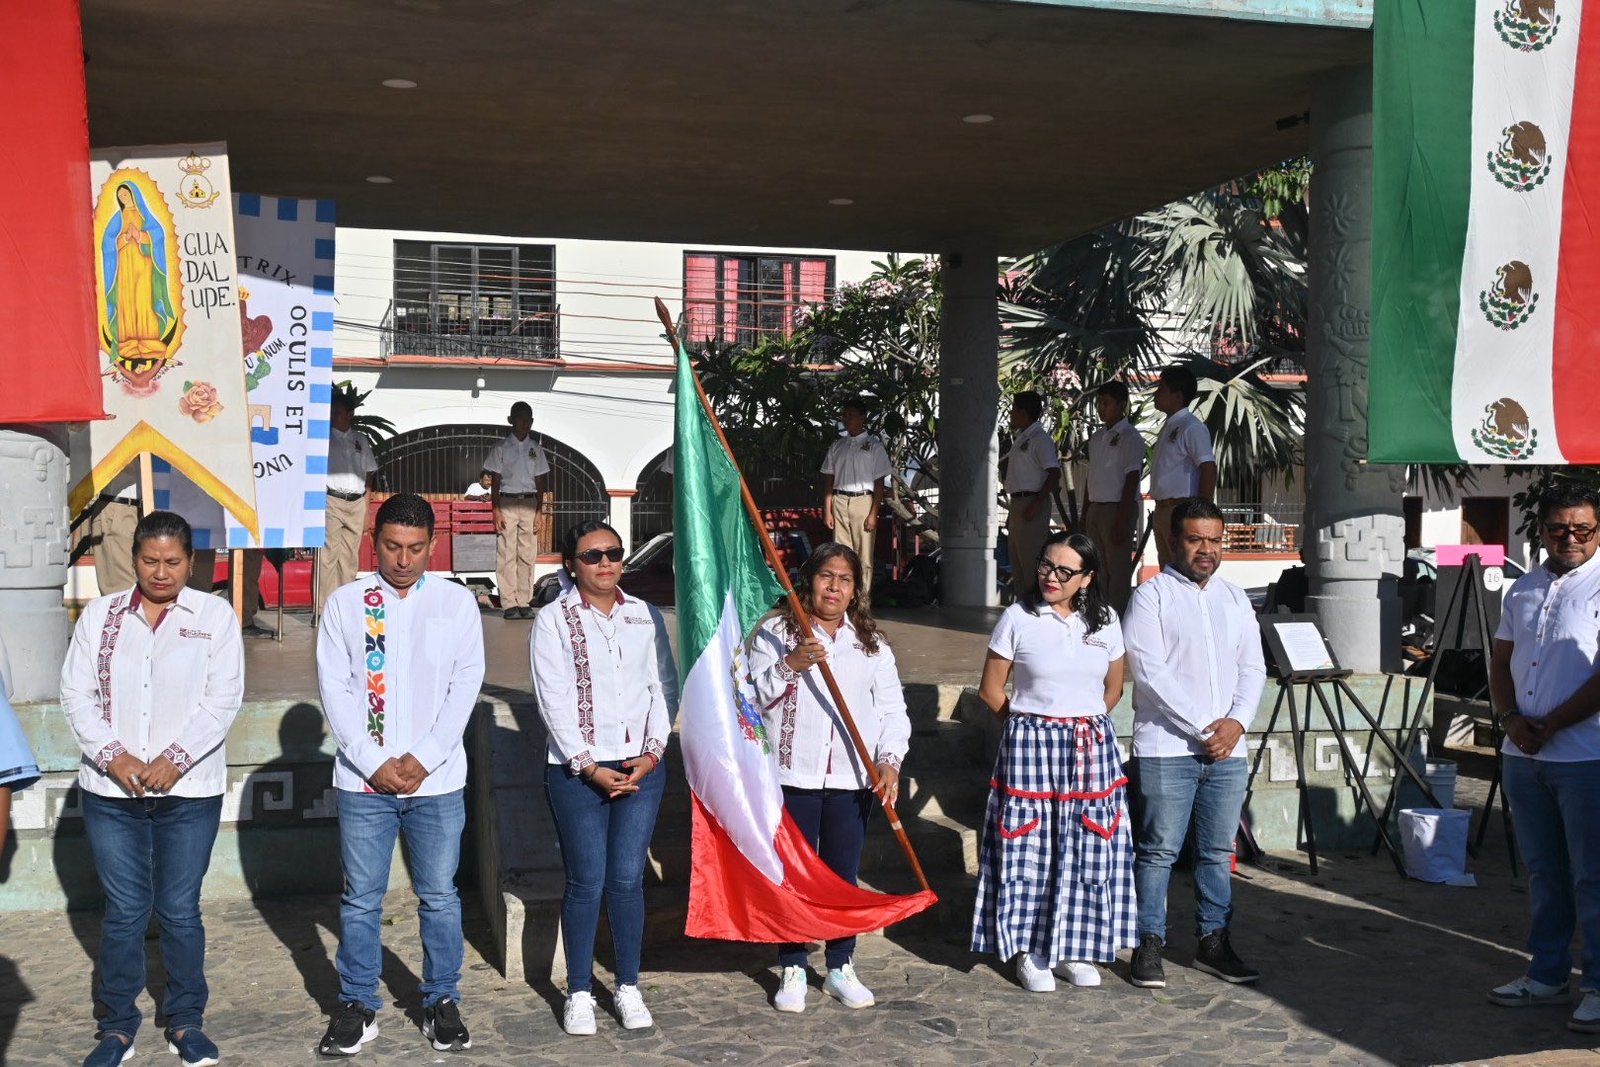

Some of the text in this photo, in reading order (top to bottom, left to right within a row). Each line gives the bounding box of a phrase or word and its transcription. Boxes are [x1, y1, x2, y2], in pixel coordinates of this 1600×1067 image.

[184, 232, 229, 256] GUA
[185, 260, 230, 284] DAL
[287, 305, 307, 391] OCULIS
[285, 405, 304, 435] ET
[1487, 572, 1500, 583] 16
